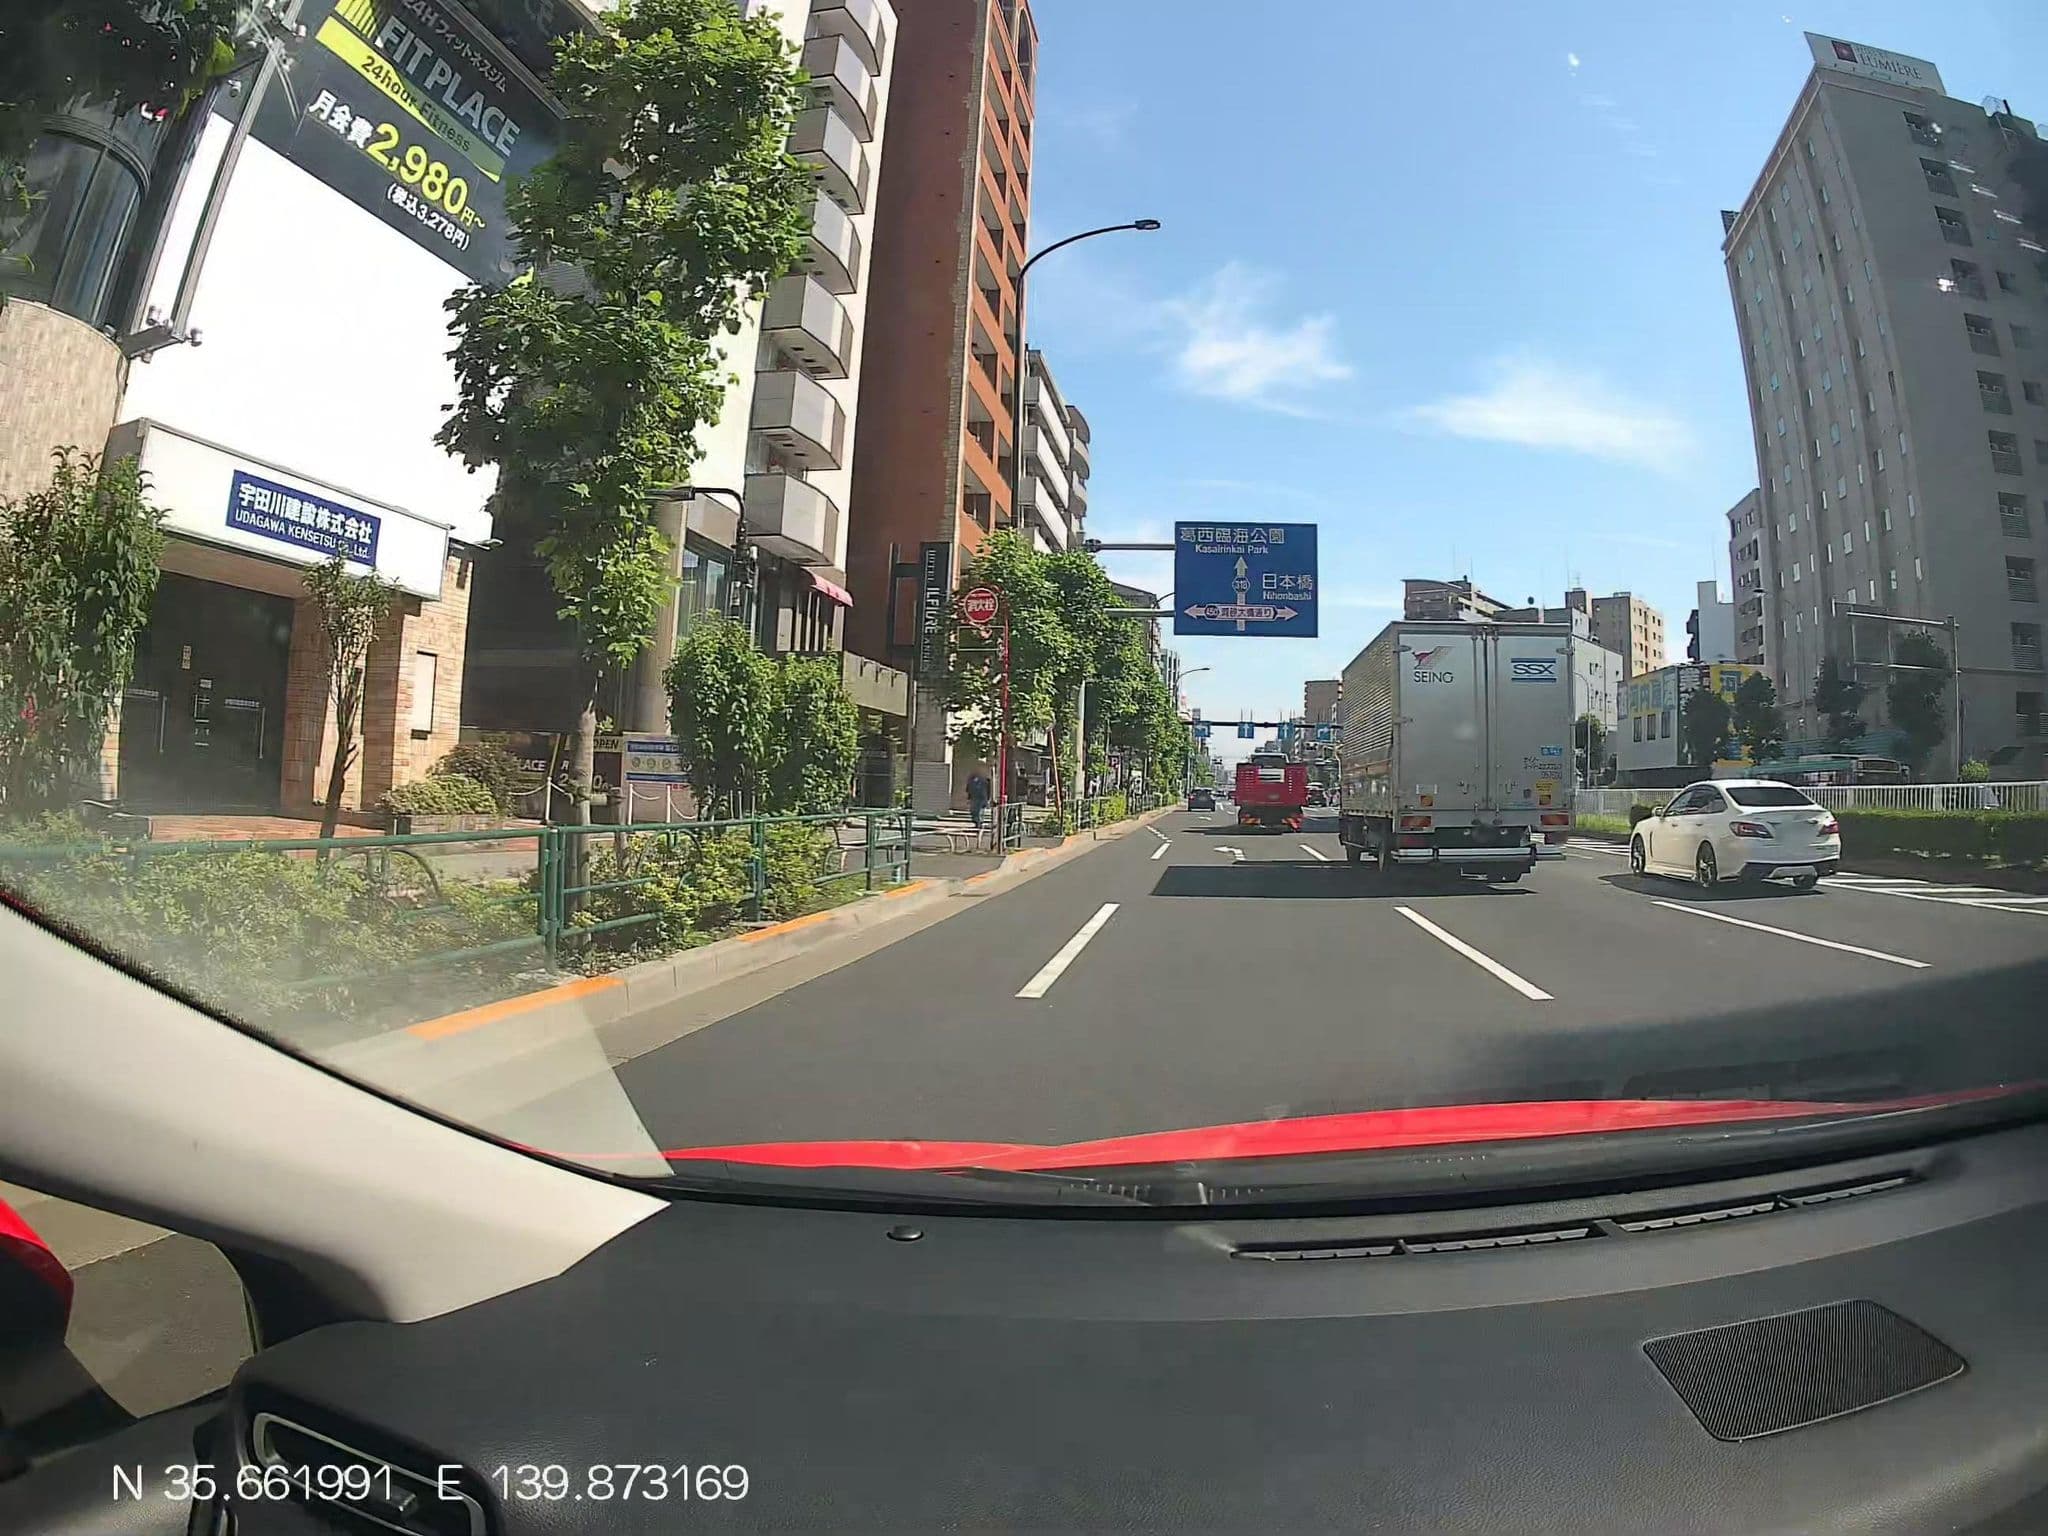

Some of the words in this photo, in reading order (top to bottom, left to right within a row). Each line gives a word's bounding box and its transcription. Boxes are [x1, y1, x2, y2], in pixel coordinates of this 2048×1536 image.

[380, 15, 434, 76] FIT
[423, 57, 521, 158] PLACE
[362, 55, 418, 109] 24hour
[419, 101, 471, 151] Fitness
[238, 482, 373, 545] 宇田川建設株式会社
[235, 507, 286, 535] UDAGAWA
[287, 523, 337, 549] KENSETSU
[1180, 527, 1285, 544] 葛西臨海公園
[1247, 545, 1268, 554] Park
[1263, 573, 1313, 590] 日本橋
[1262, 591, 1312, 601] Nihonbashi
[1413, 671, 1454, 683] SEINO
[1512, 663, 1555, 675] SSX
